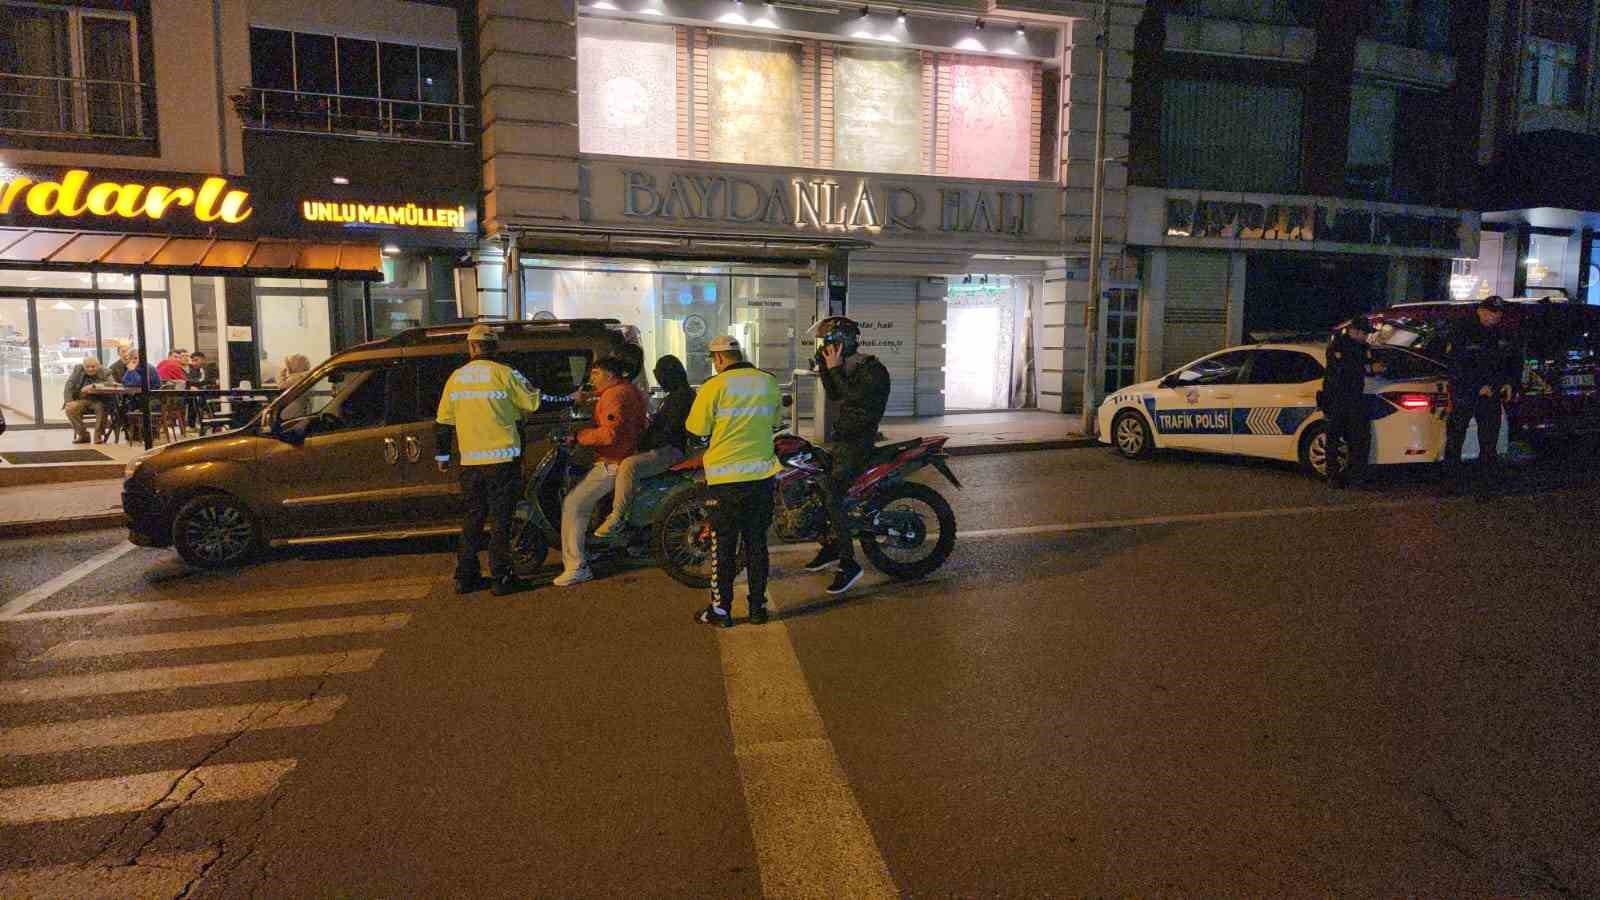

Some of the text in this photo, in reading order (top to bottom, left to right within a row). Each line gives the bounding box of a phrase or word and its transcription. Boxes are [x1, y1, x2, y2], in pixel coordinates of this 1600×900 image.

[623, 170, 923, 230] BAYDANLAR
[304, 201, 464, 227] UNLU MAMÜLLERİ
[1160, 412, 1228, 430] TRAFİK POLİSİ
